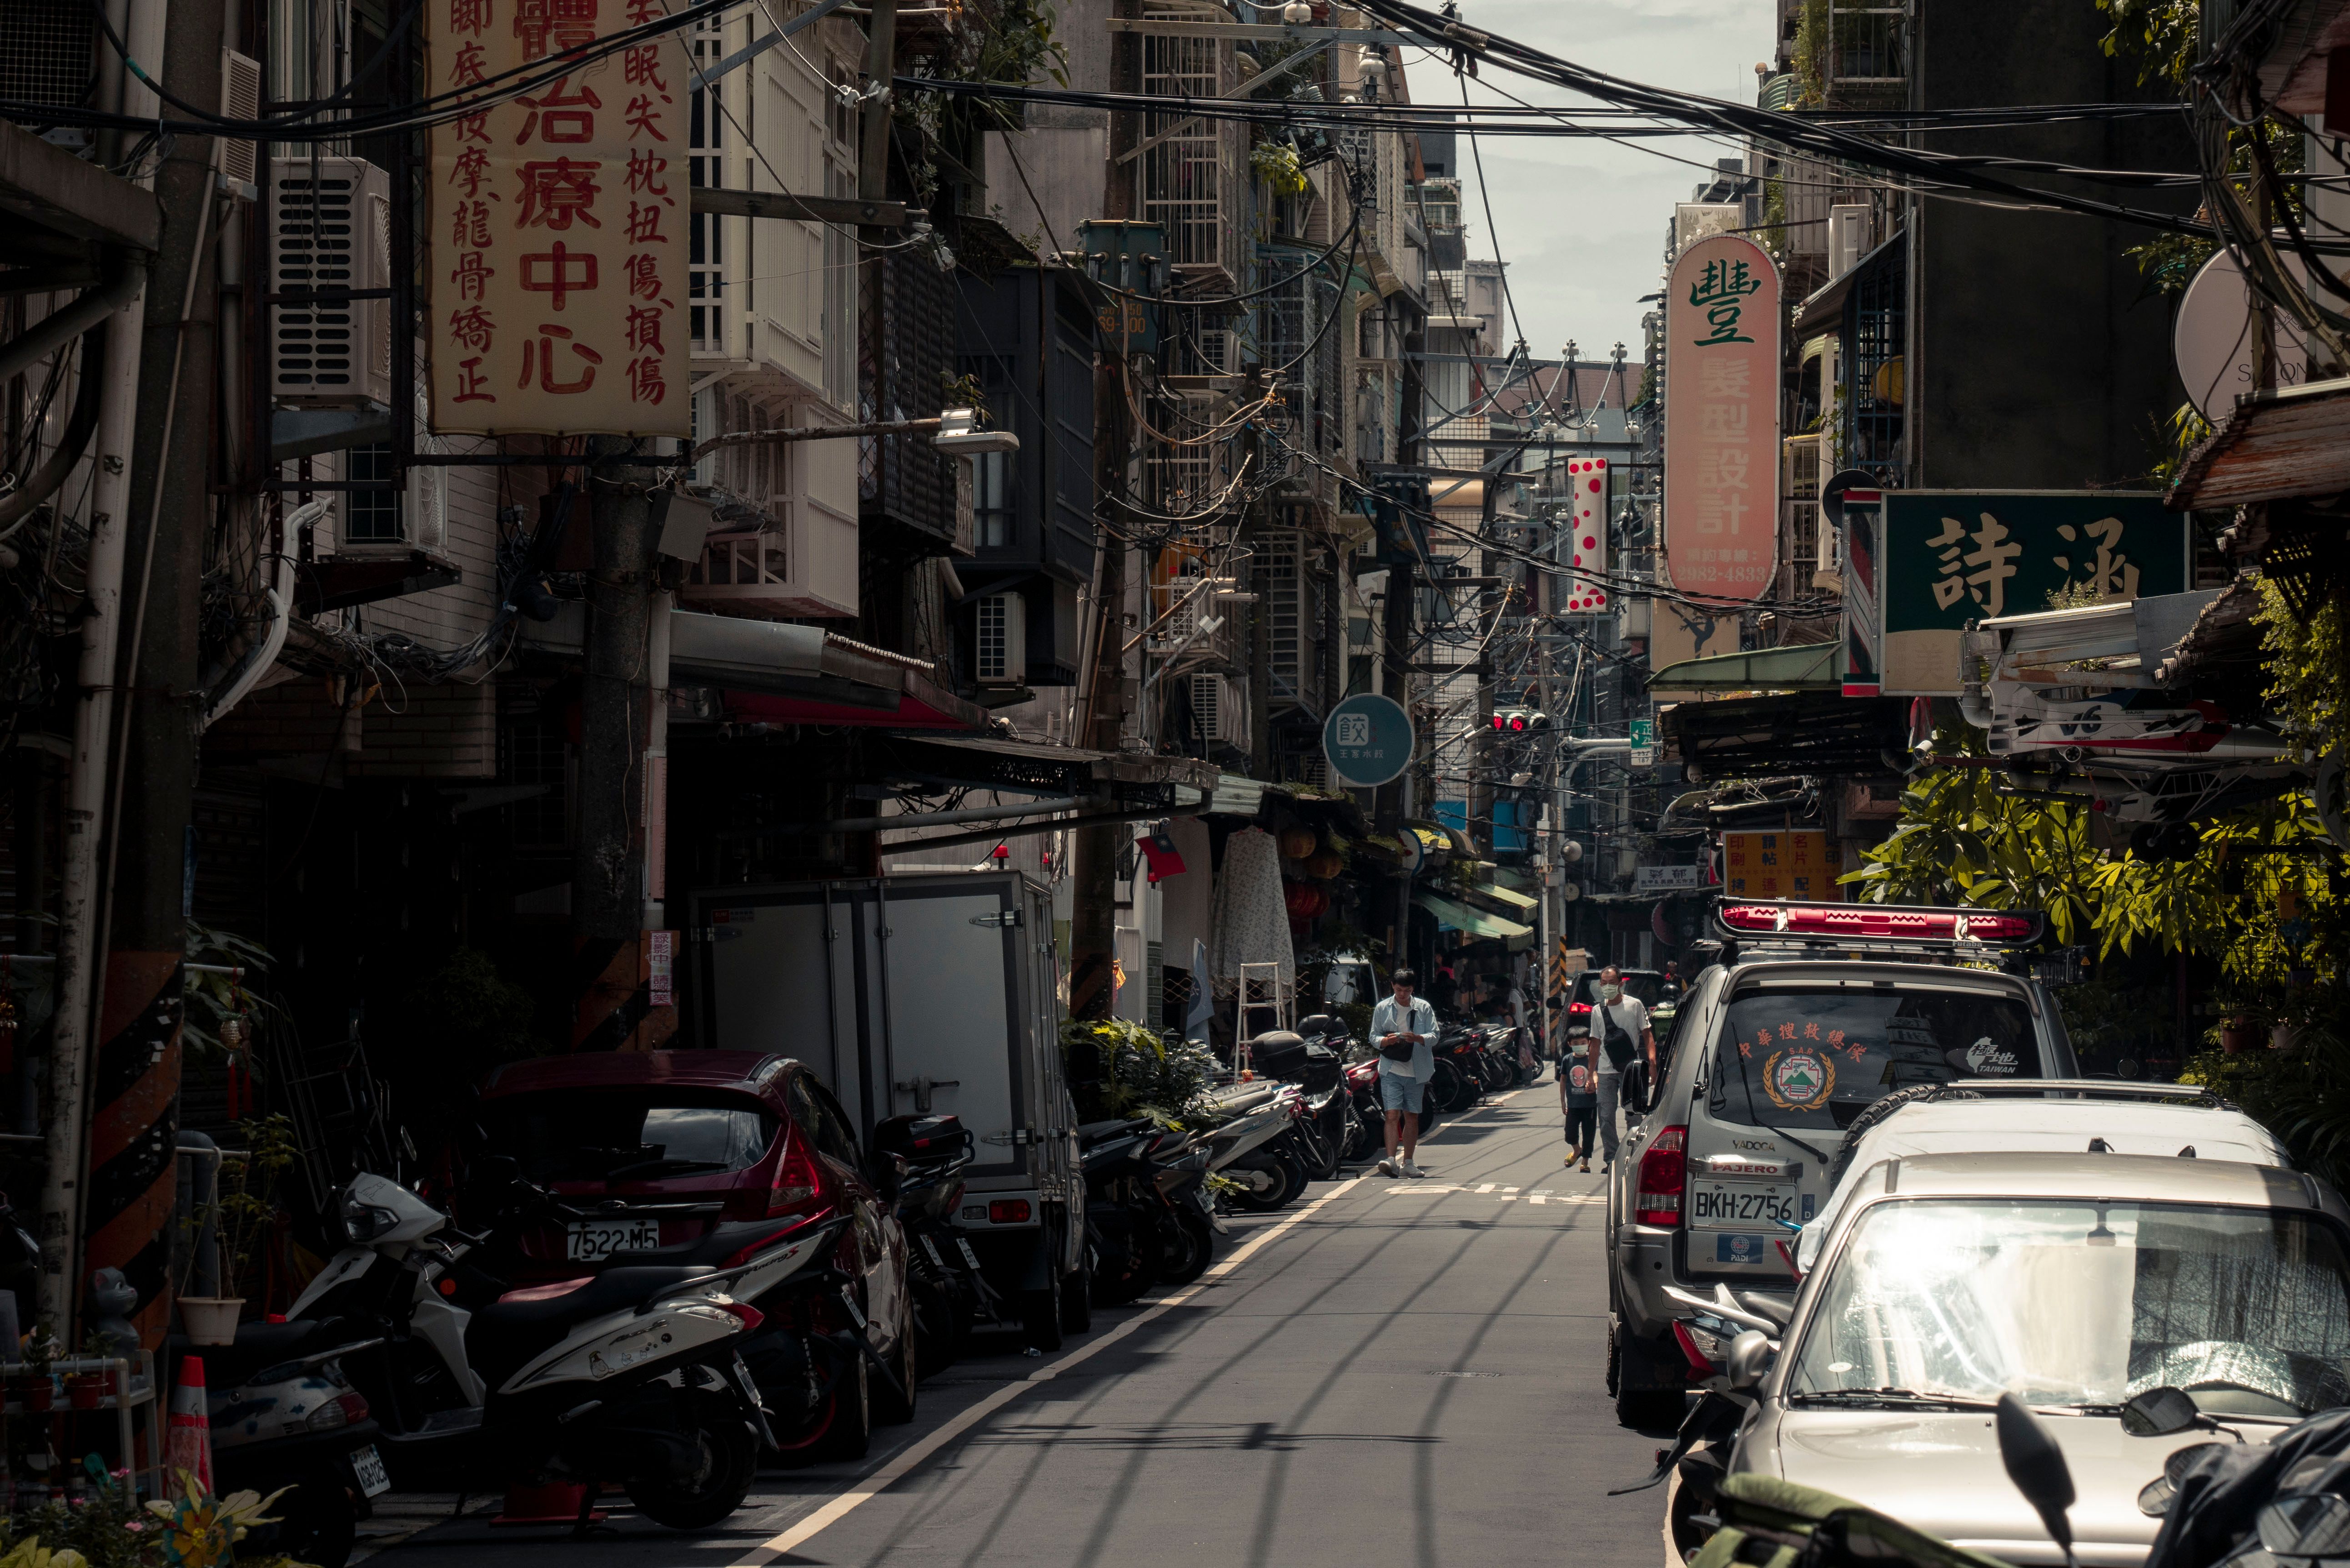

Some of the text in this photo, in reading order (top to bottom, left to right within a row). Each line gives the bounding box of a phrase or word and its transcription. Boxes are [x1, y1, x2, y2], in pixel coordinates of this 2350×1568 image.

[1689, 258, 1761, 347] 豐
[2238, 362, 2307, 383] SON
[1696, 357, 1750, 535] 髮型設計
[1925, 512, 2141, 618] 詩涵
[1340, 717, 1366, 742] 餃
[1340, 749, 1384, 759] 王家水餃
[1730, 835, 1744, 866] 印刷
[1794, 834, 1808, 865] 名片
[653, 934, 669, 964] 錄影中
[1712, 1164, 1778, 1173] PAJERO
